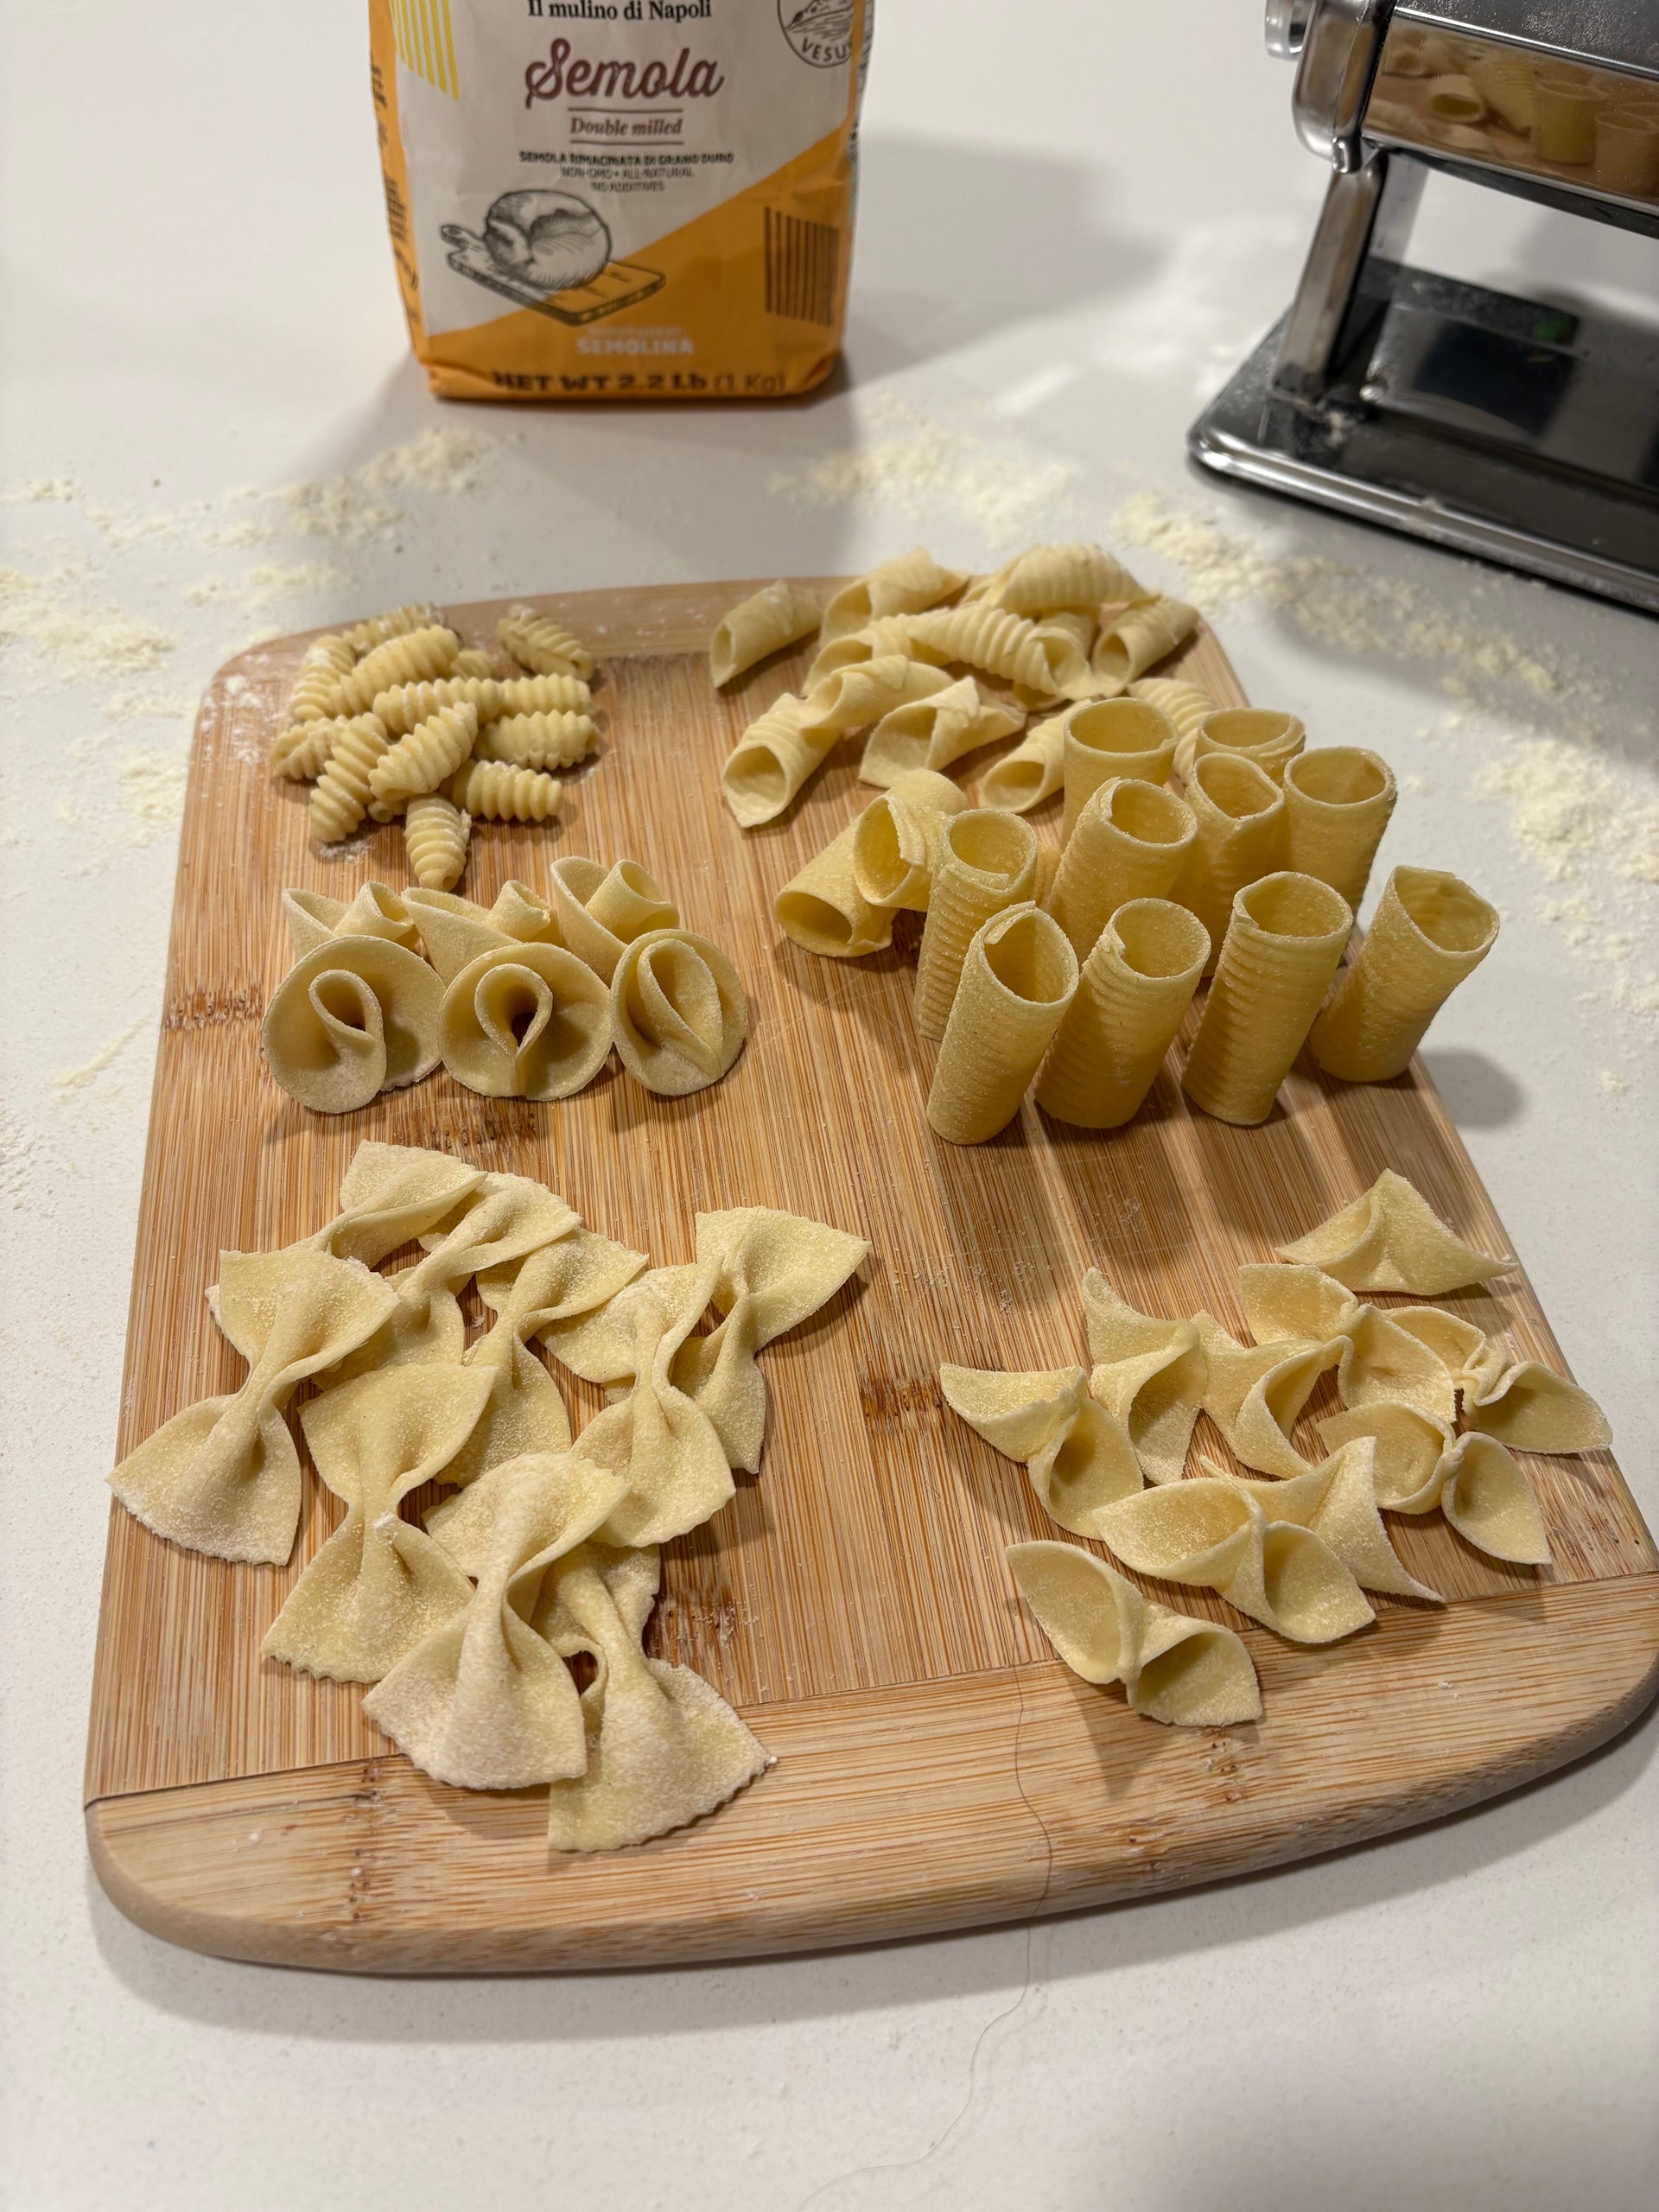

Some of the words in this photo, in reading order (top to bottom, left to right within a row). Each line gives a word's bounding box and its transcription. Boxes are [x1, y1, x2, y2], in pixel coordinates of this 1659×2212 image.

[527, 0, 543, 16] Il
[549, 0, 618, 20] mulino
[624, 0, 643, 20] di
[649, 0, 712, 22] Napoli
[525, 37, 725, 110] Semola
[570, 117, 626, 136] Double
[631, 118, 683, 136] milled
[519, 151, 567, 163] SEMOLA
[576, 337, 694, 355] SEMOLINA
[493, 372, 550, 391] NET
[561, 374, 608, 391] WT
[671, 372, 707, 390] Lb
